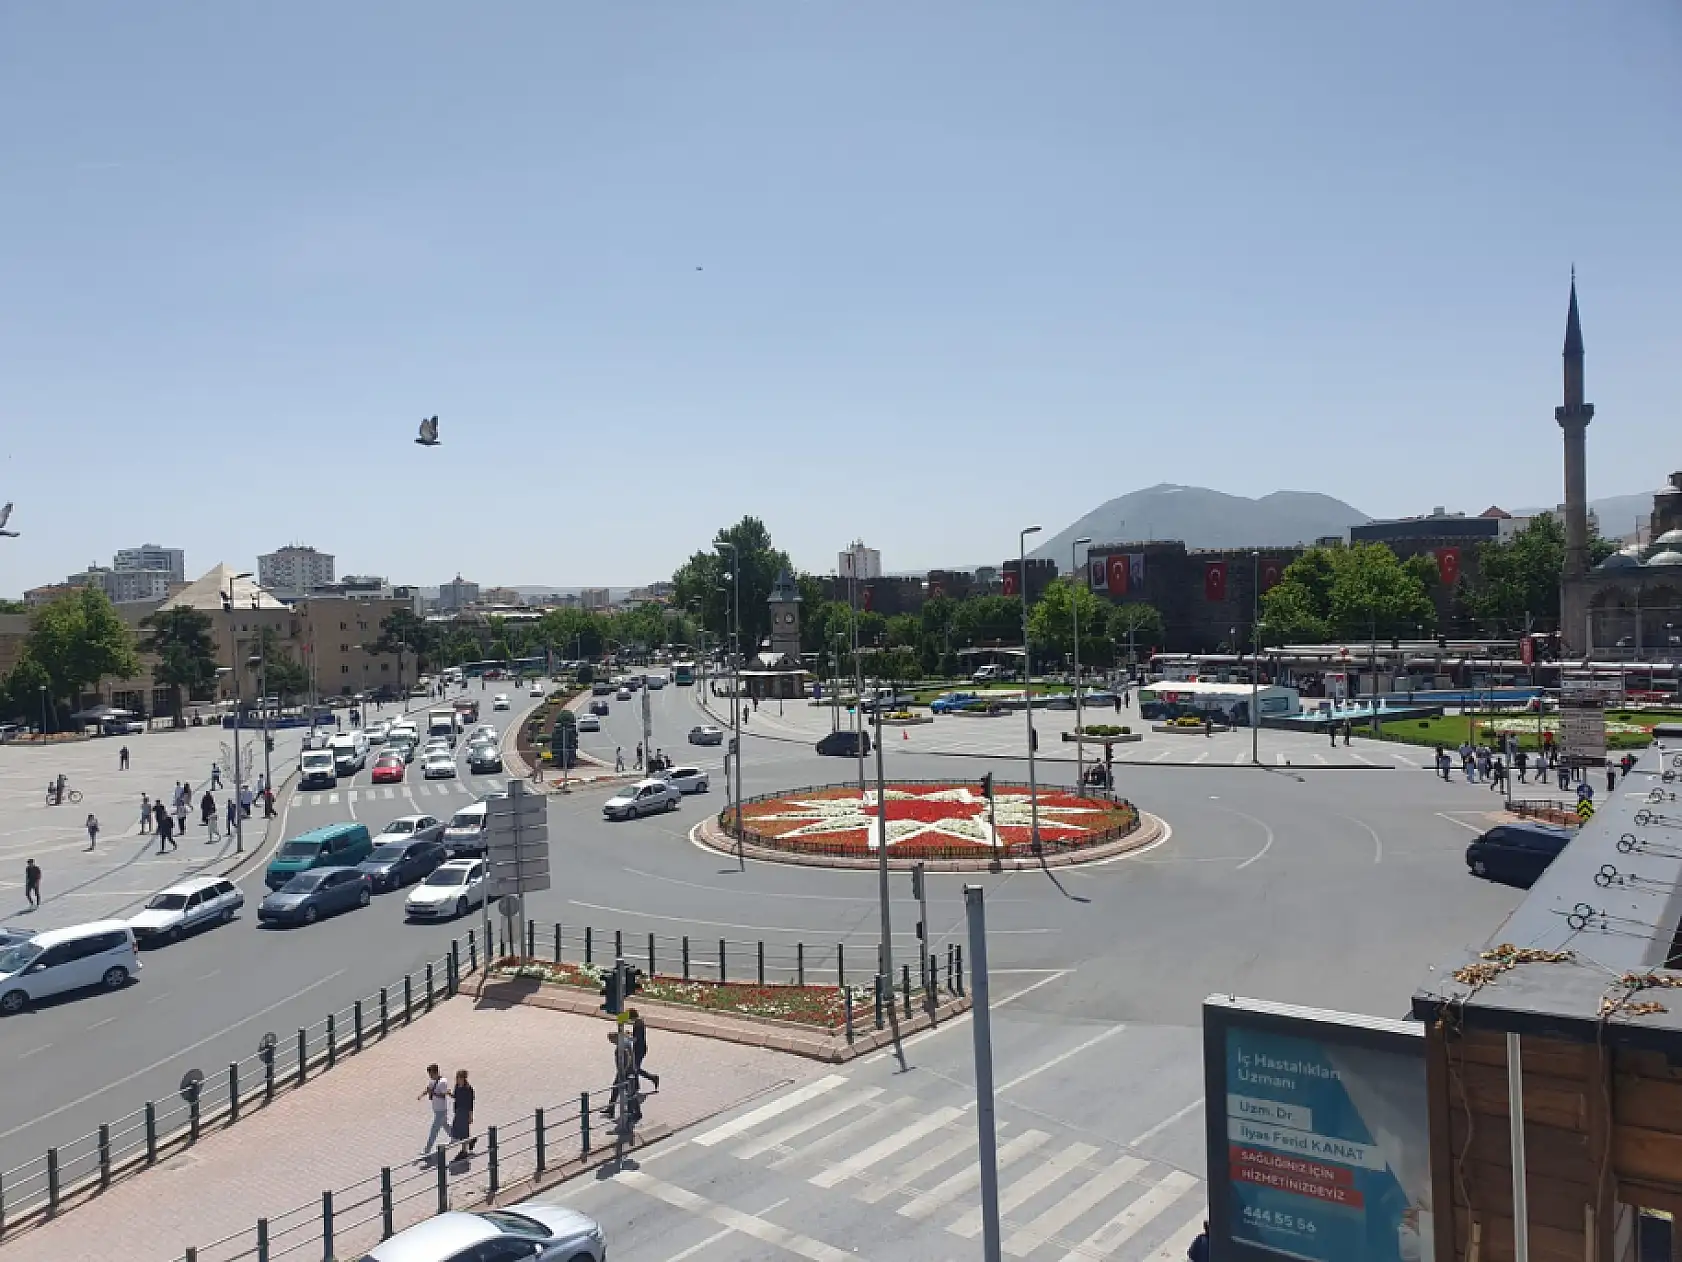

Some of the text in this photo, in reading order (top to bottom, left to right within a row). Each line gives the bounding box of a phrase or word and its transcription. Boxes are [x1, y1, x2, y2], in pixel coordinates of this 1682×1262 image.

[1237, 1068, 1296, 1090] Uzmanı
[1311, 1139, 1365, 1160] KANAT
[1243, 1205, 1271, 1222] 444
[1274, 1211, 1293, 1227] 55
